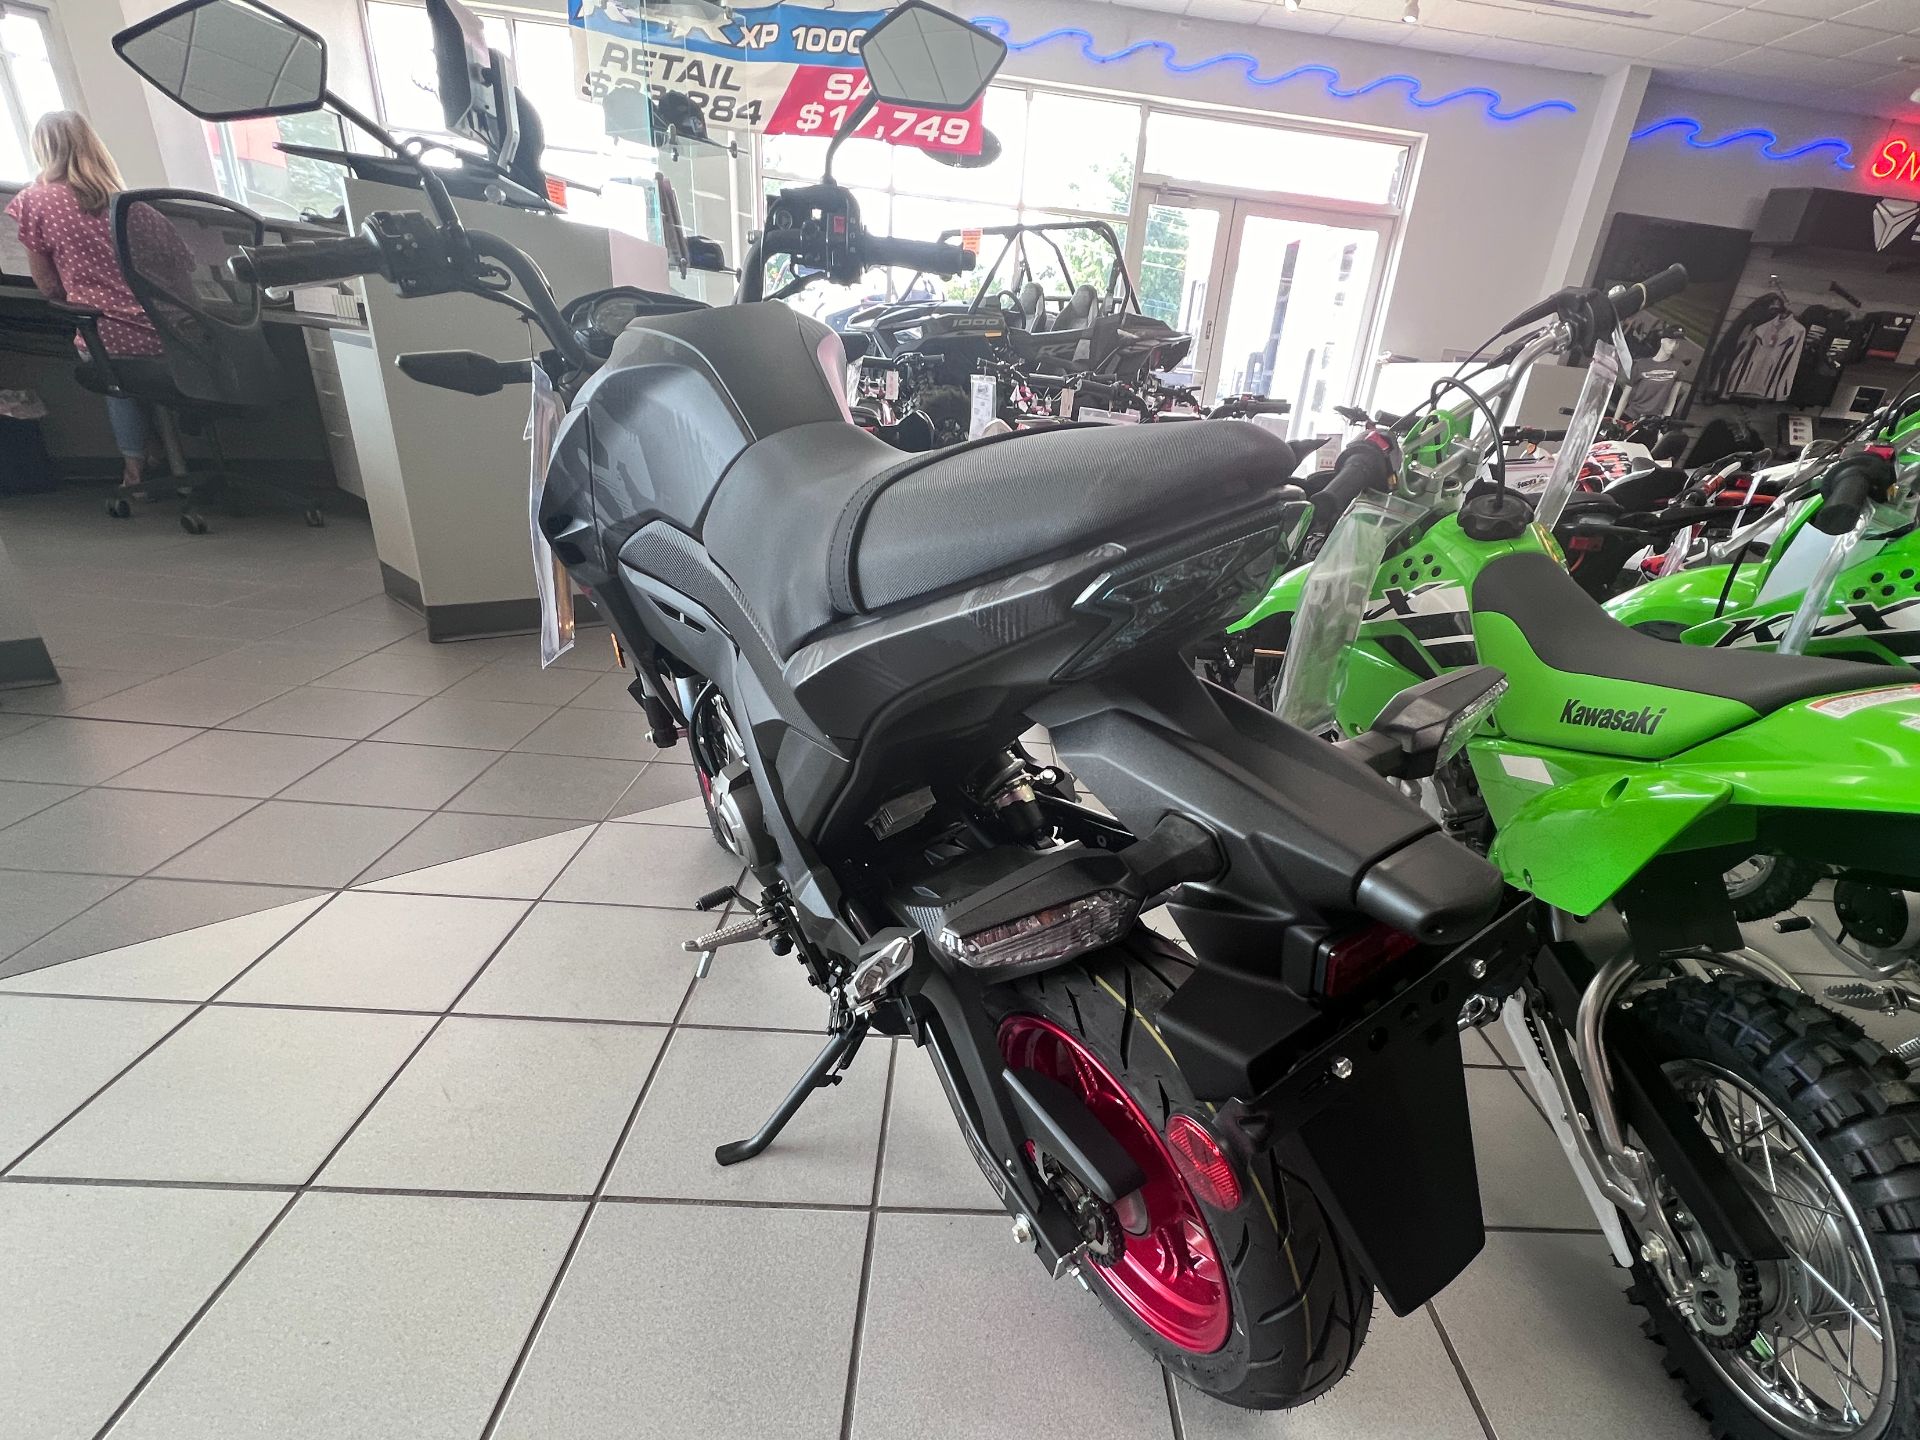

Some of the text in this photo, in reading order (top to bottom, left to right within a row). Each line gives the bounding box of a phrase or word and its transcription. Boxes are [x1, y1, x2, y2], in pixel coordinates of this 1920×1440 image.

[736, 24, 779, 49] XP
[600, 41, 742, 92] RETAIL
[952, 318, 1000, 328] 1000
[1560, 698, 1667, 735] Kawasaki
